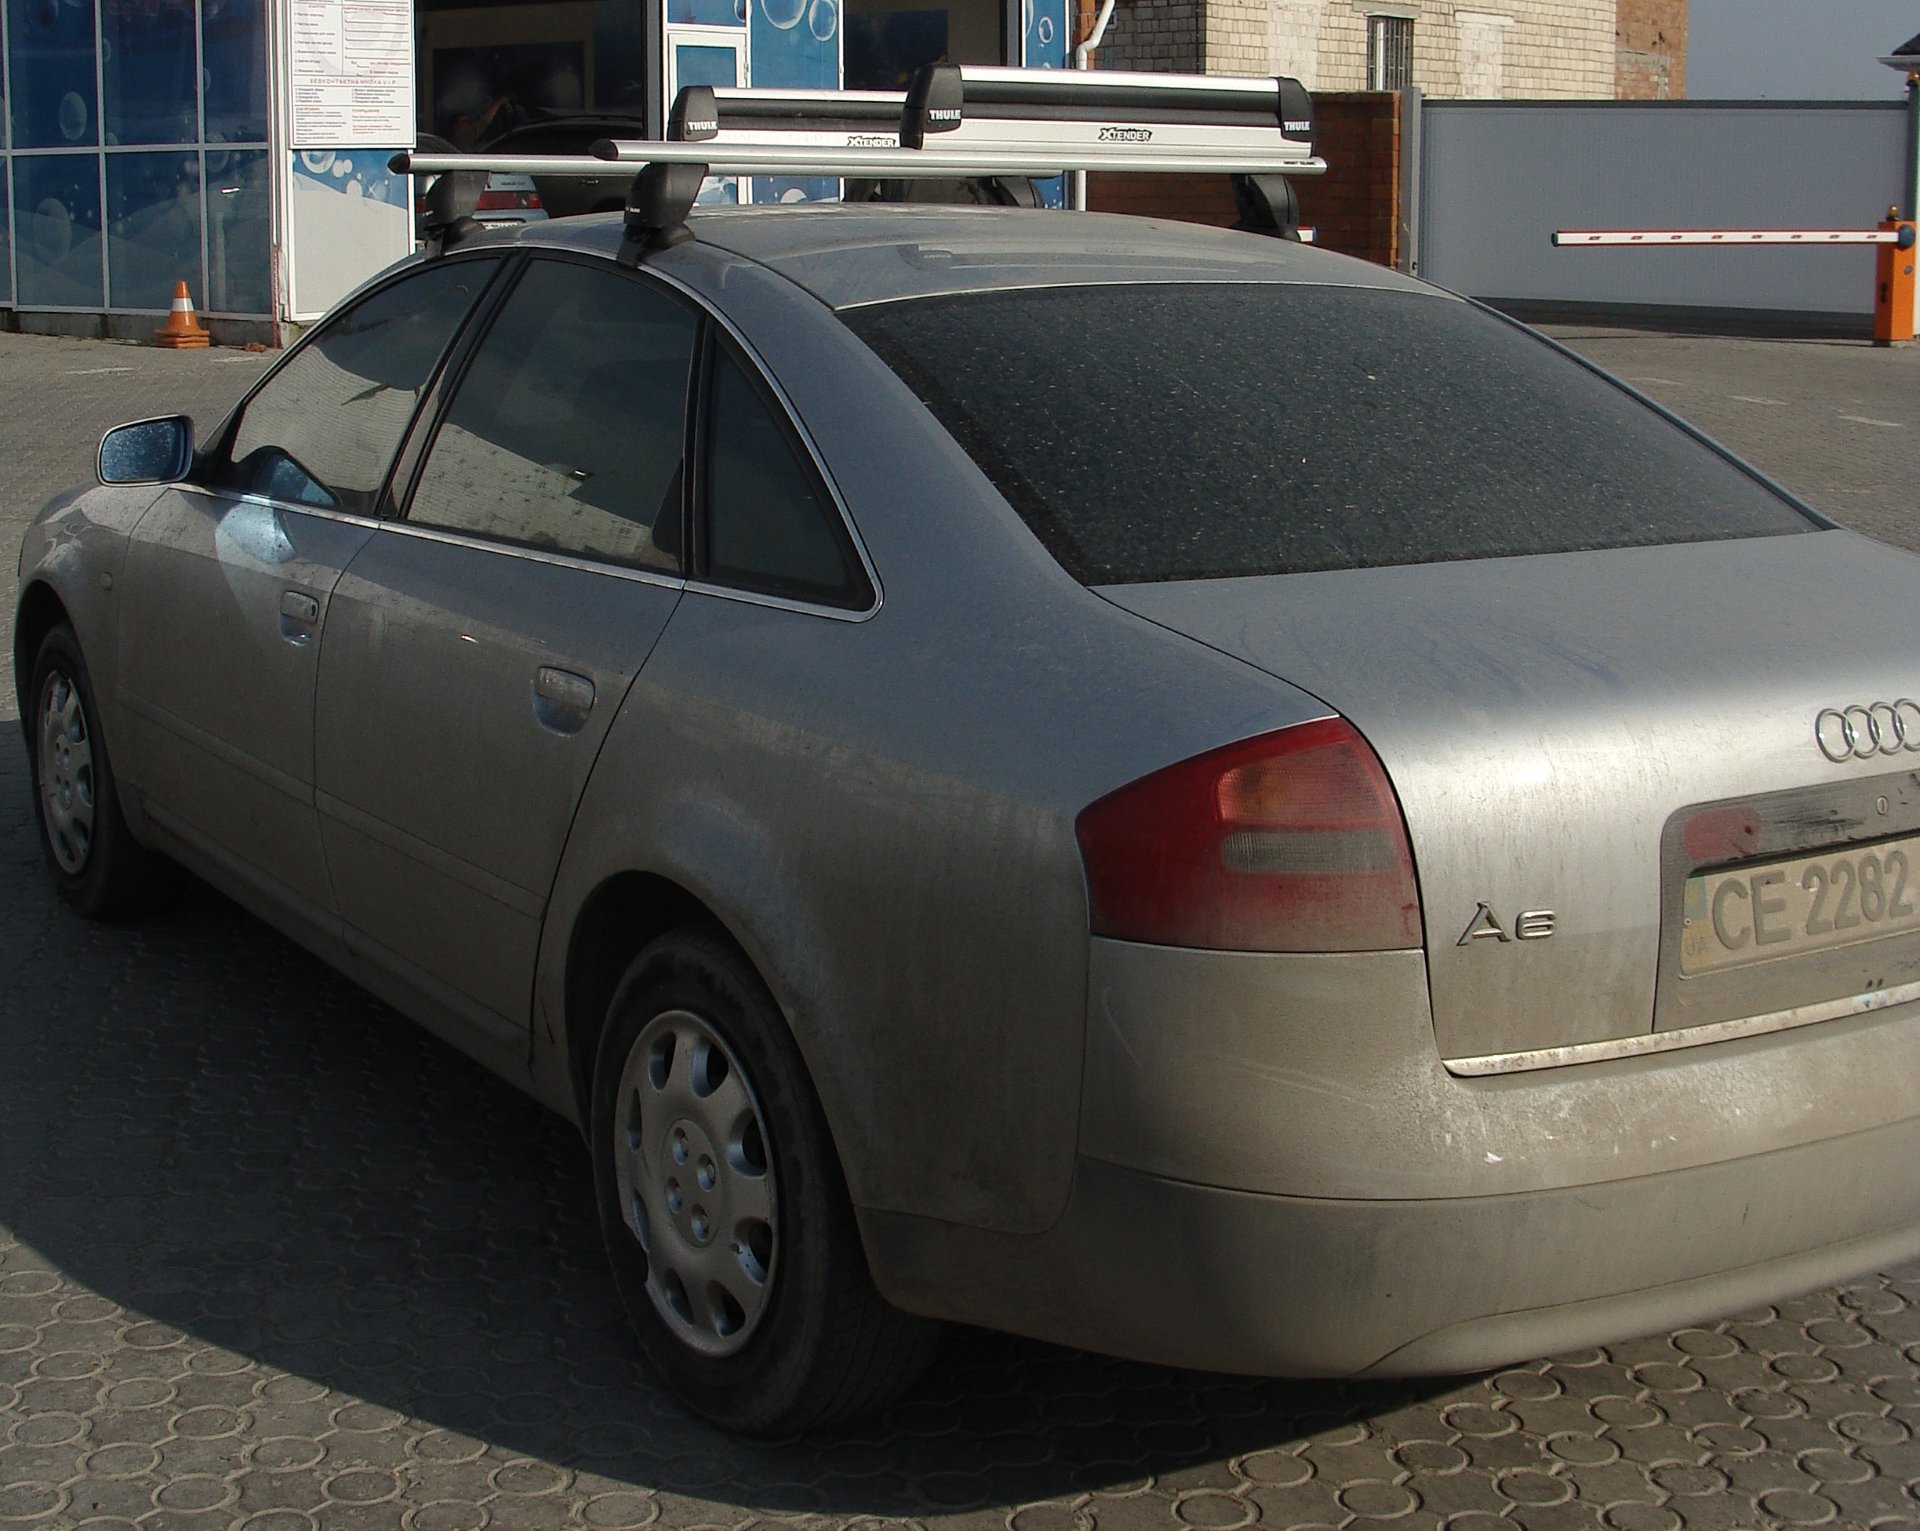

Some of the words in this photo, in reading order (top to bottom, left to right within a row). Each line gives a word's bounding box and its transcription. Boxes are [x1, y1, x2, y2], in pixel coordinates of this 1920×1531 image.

[929, 109, 962, 120] THULE
[687, 121, 718, 131] THULE
[1283, 121, 1311, 132] THULE
[1098, 127, 1152, 142] XTENDER
[847, 136, 897, 148] XTENDER
[1801, 850, 1914, 936] 2282
[1456, 901, 1557, 946] A6
